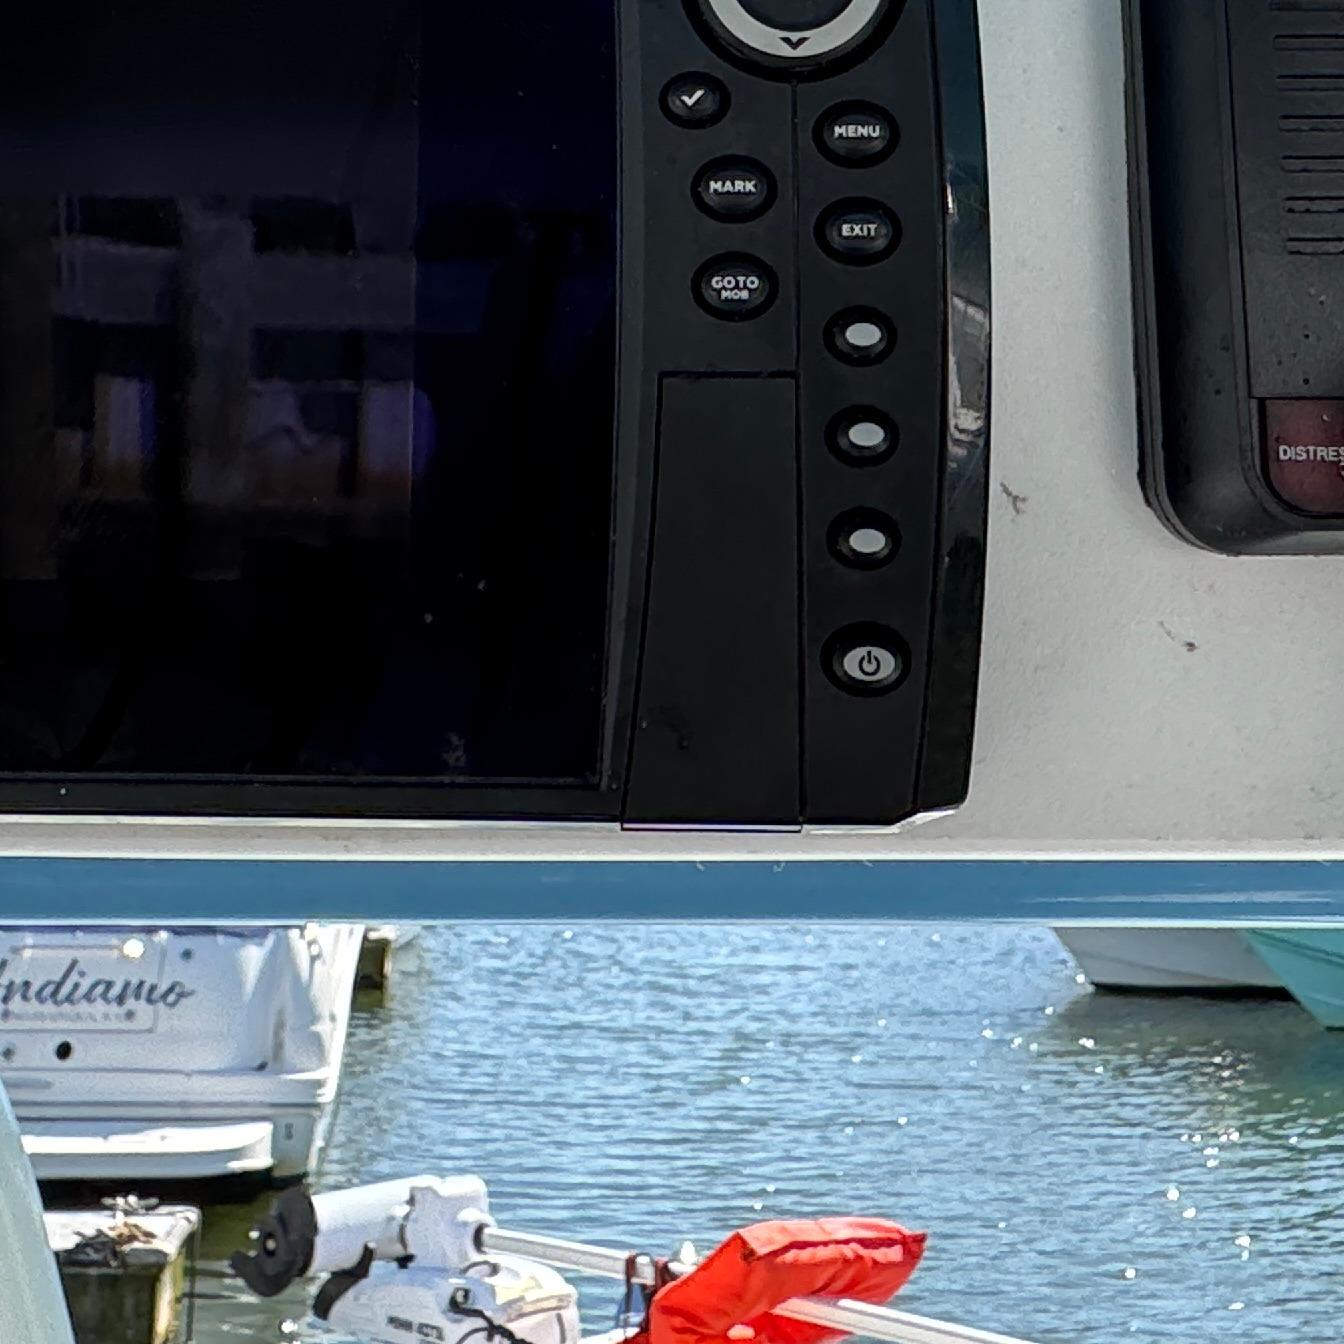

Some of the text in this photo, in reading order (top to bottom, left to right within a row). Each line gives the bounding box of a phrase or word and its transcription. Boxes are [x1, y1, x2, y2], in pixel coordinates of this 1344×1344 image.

[833, 124, 880, 138] MENU
[709, 179, 757, 194] MARK
[841, 223, 878, 237] EXIT
[720, 288, 750, 300] MOB
